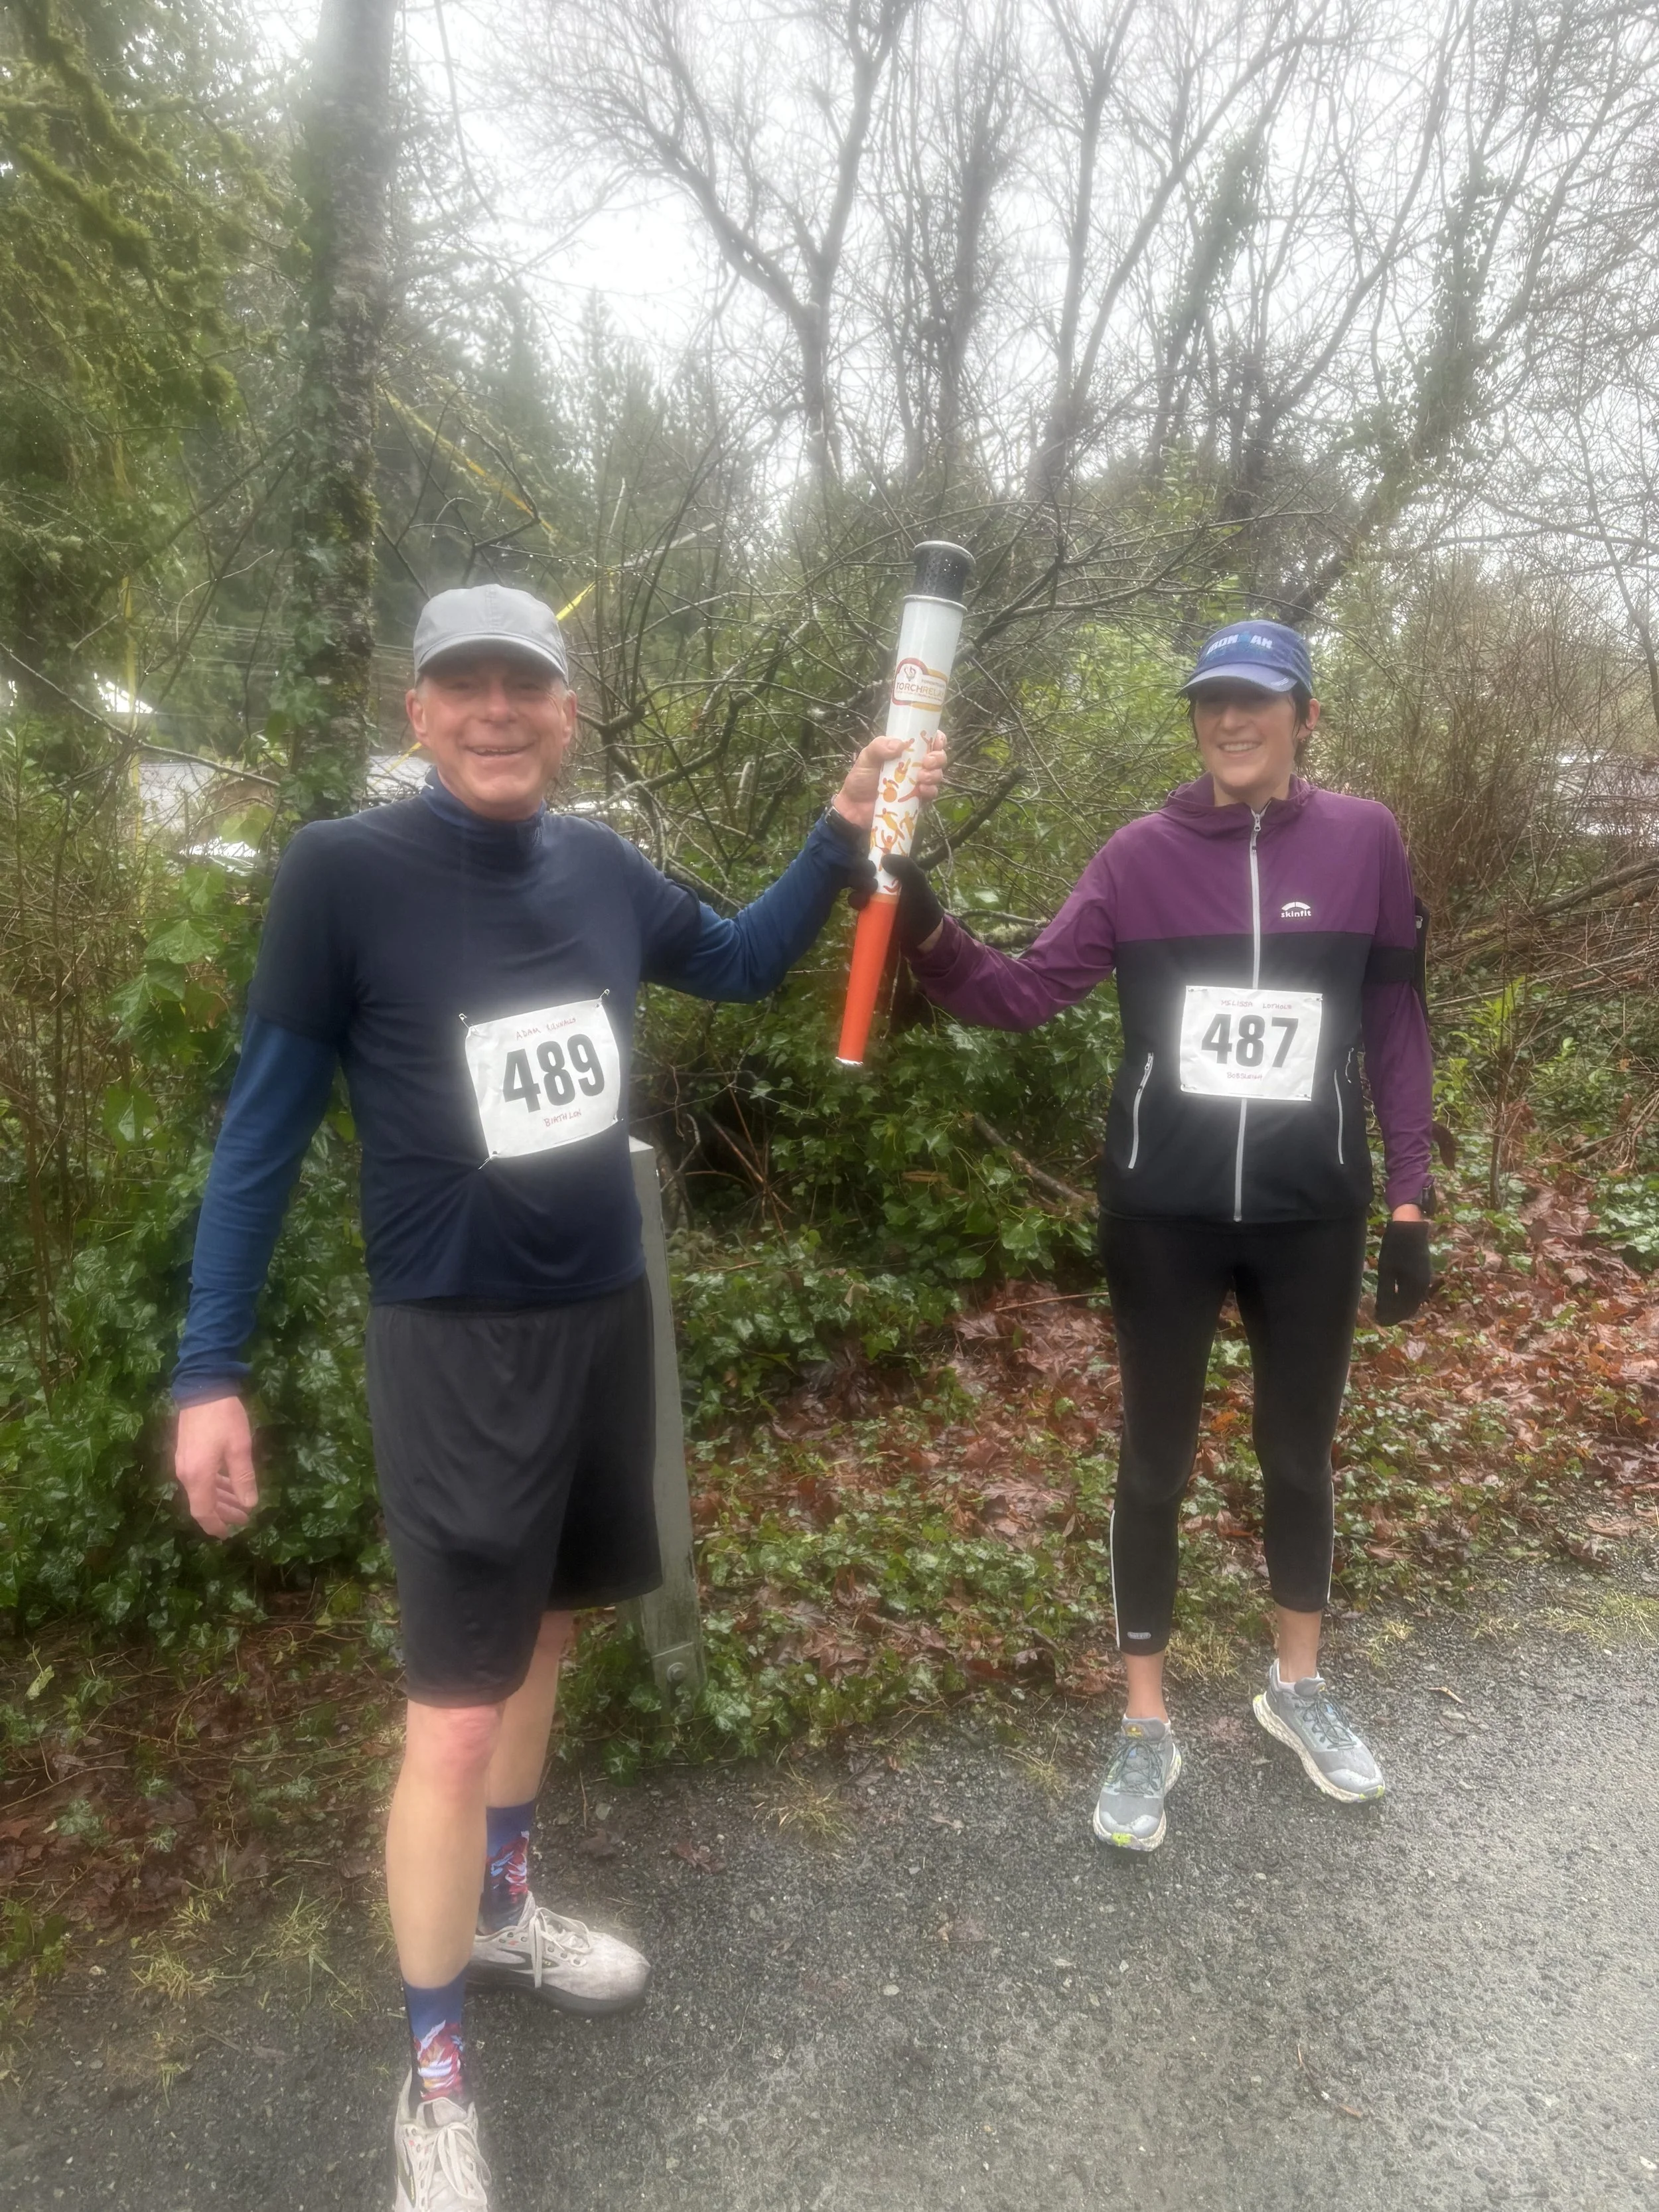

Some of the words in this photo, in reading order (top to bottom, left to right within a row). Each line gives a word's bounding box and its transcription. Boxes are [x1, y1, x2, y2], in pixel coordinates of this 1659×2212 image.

[516, 1027, 541, 1041] ADAM
[1201, 1013, 1299, 1068] 487
[502, 1034, 605, 1113] 489
[543, 1108, 582, 1127] BIATHLON
